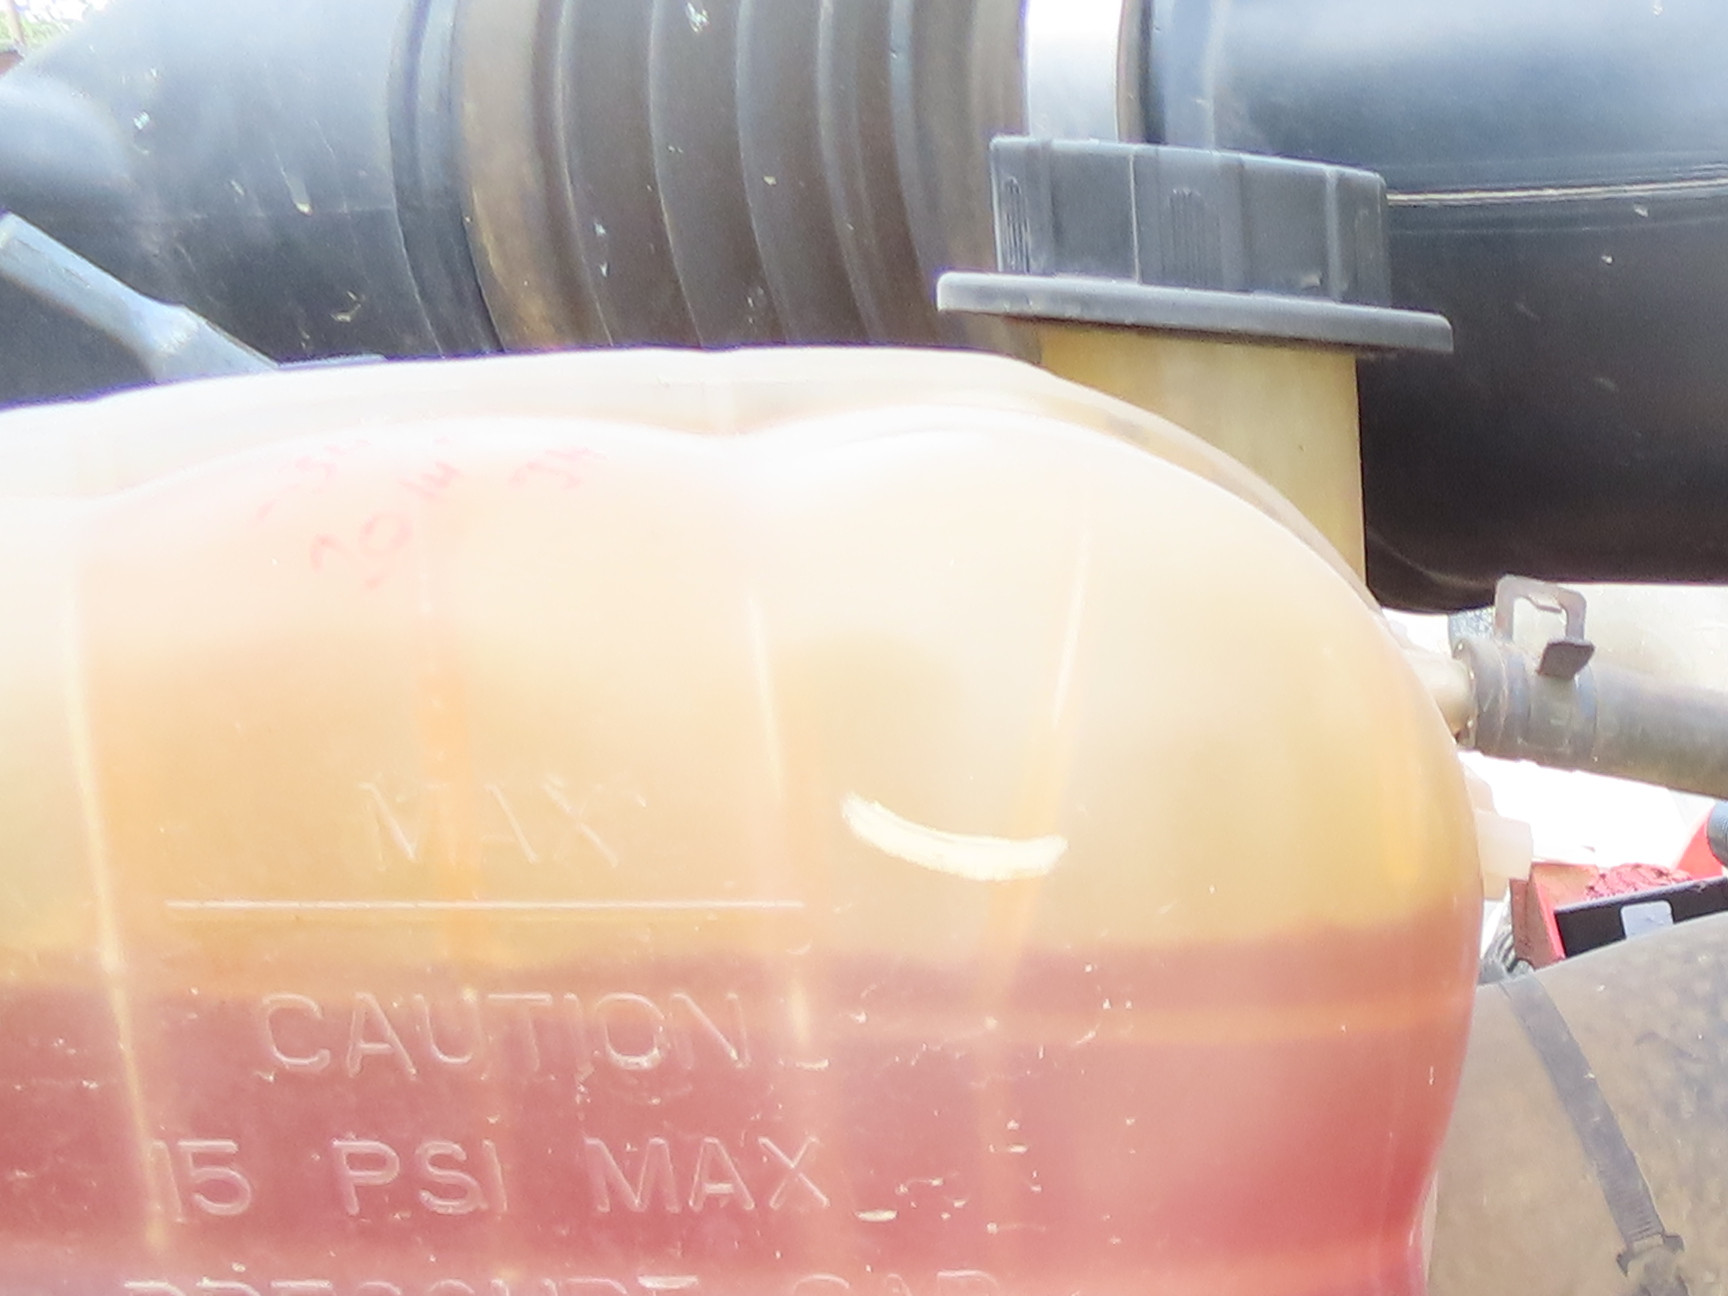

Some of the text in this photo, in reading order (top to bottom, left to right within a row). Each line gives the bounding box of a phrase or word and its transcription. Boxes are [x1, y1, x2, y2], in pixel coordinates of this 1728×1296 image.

[256, 990, 753, 1082] CAUTION
[149, 1135, 831, 1222] 15 PSI MAX
